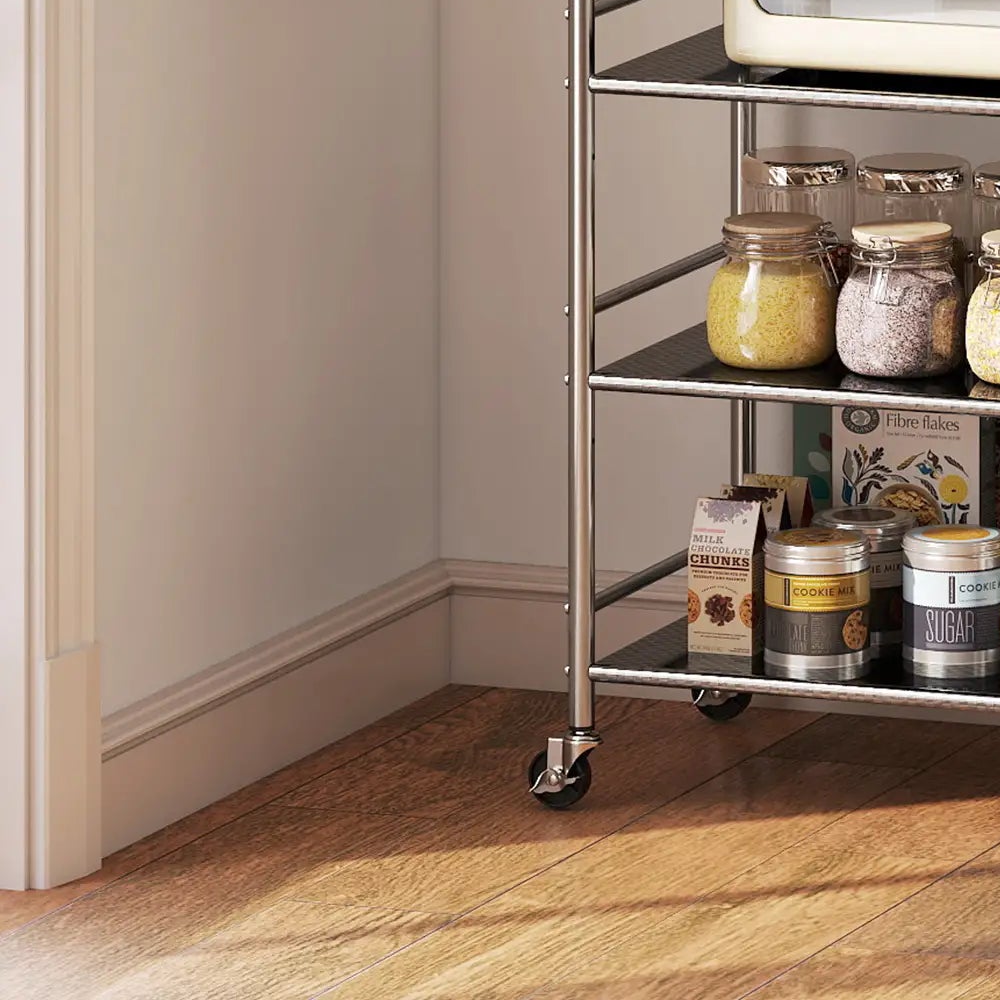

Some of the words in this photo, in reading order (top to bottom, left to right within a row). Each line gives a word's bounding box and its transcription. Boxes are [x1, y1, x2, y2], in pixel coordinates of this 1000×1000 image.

[886, 412, 919, 430] Fibre
[922, 414, 960, 432] flakes
[692, 534, 724, 544] MILK
[690, 544, 751, 556] CHOCOLATE
[690, 553, 750, 568] CHUNKS
[792, 586, 835, 597] COOKIE
[837, 585, 856, 596] MIX
[959, 581, 997, 593] COOKIE
[925, 608, 975, 644] SUGAR
